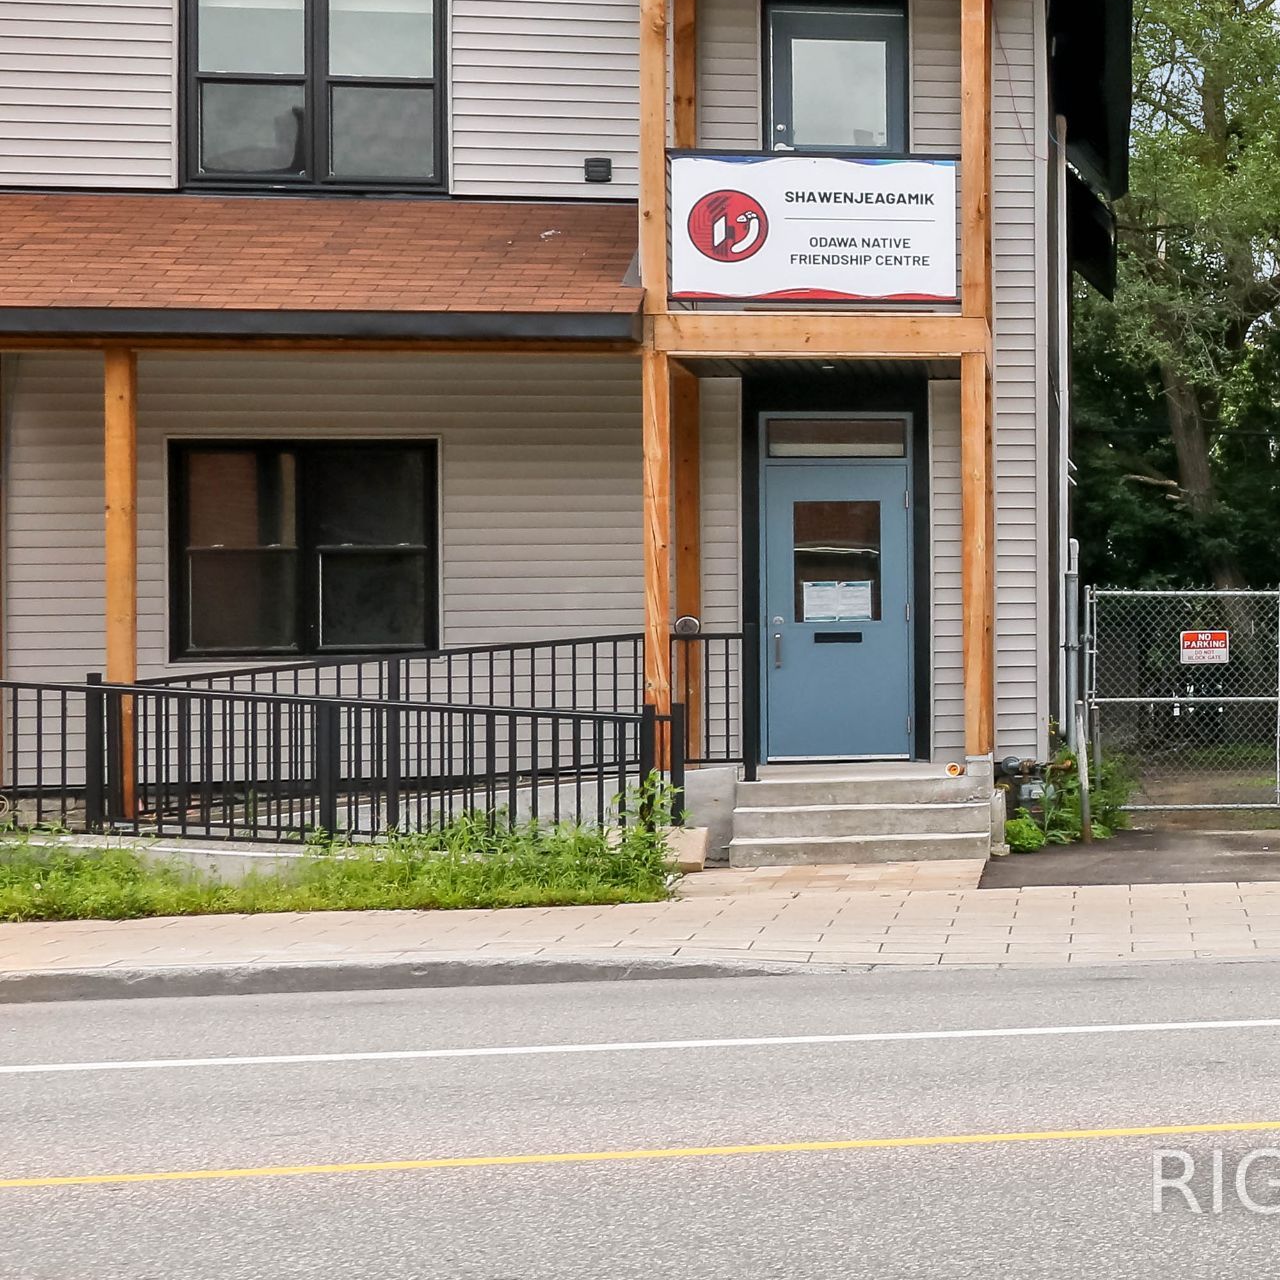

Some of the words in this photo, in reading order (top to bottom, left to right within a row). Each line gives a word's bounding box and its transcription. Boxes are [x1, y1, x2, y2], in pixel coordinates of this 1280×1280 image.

[784, 190, 936, 206] SHAWENJEAGAMIK
[809, 236, 859, 249] ODAWA
[861, 237, 911, 250] NATIVE
[790, 253, 872, 266] FRIENDSHIP
[875, 254, 931, 267] CENTRE
[1198, 633, 1212, 641] NO
[1183, 640, 1226, 649] PARKING
